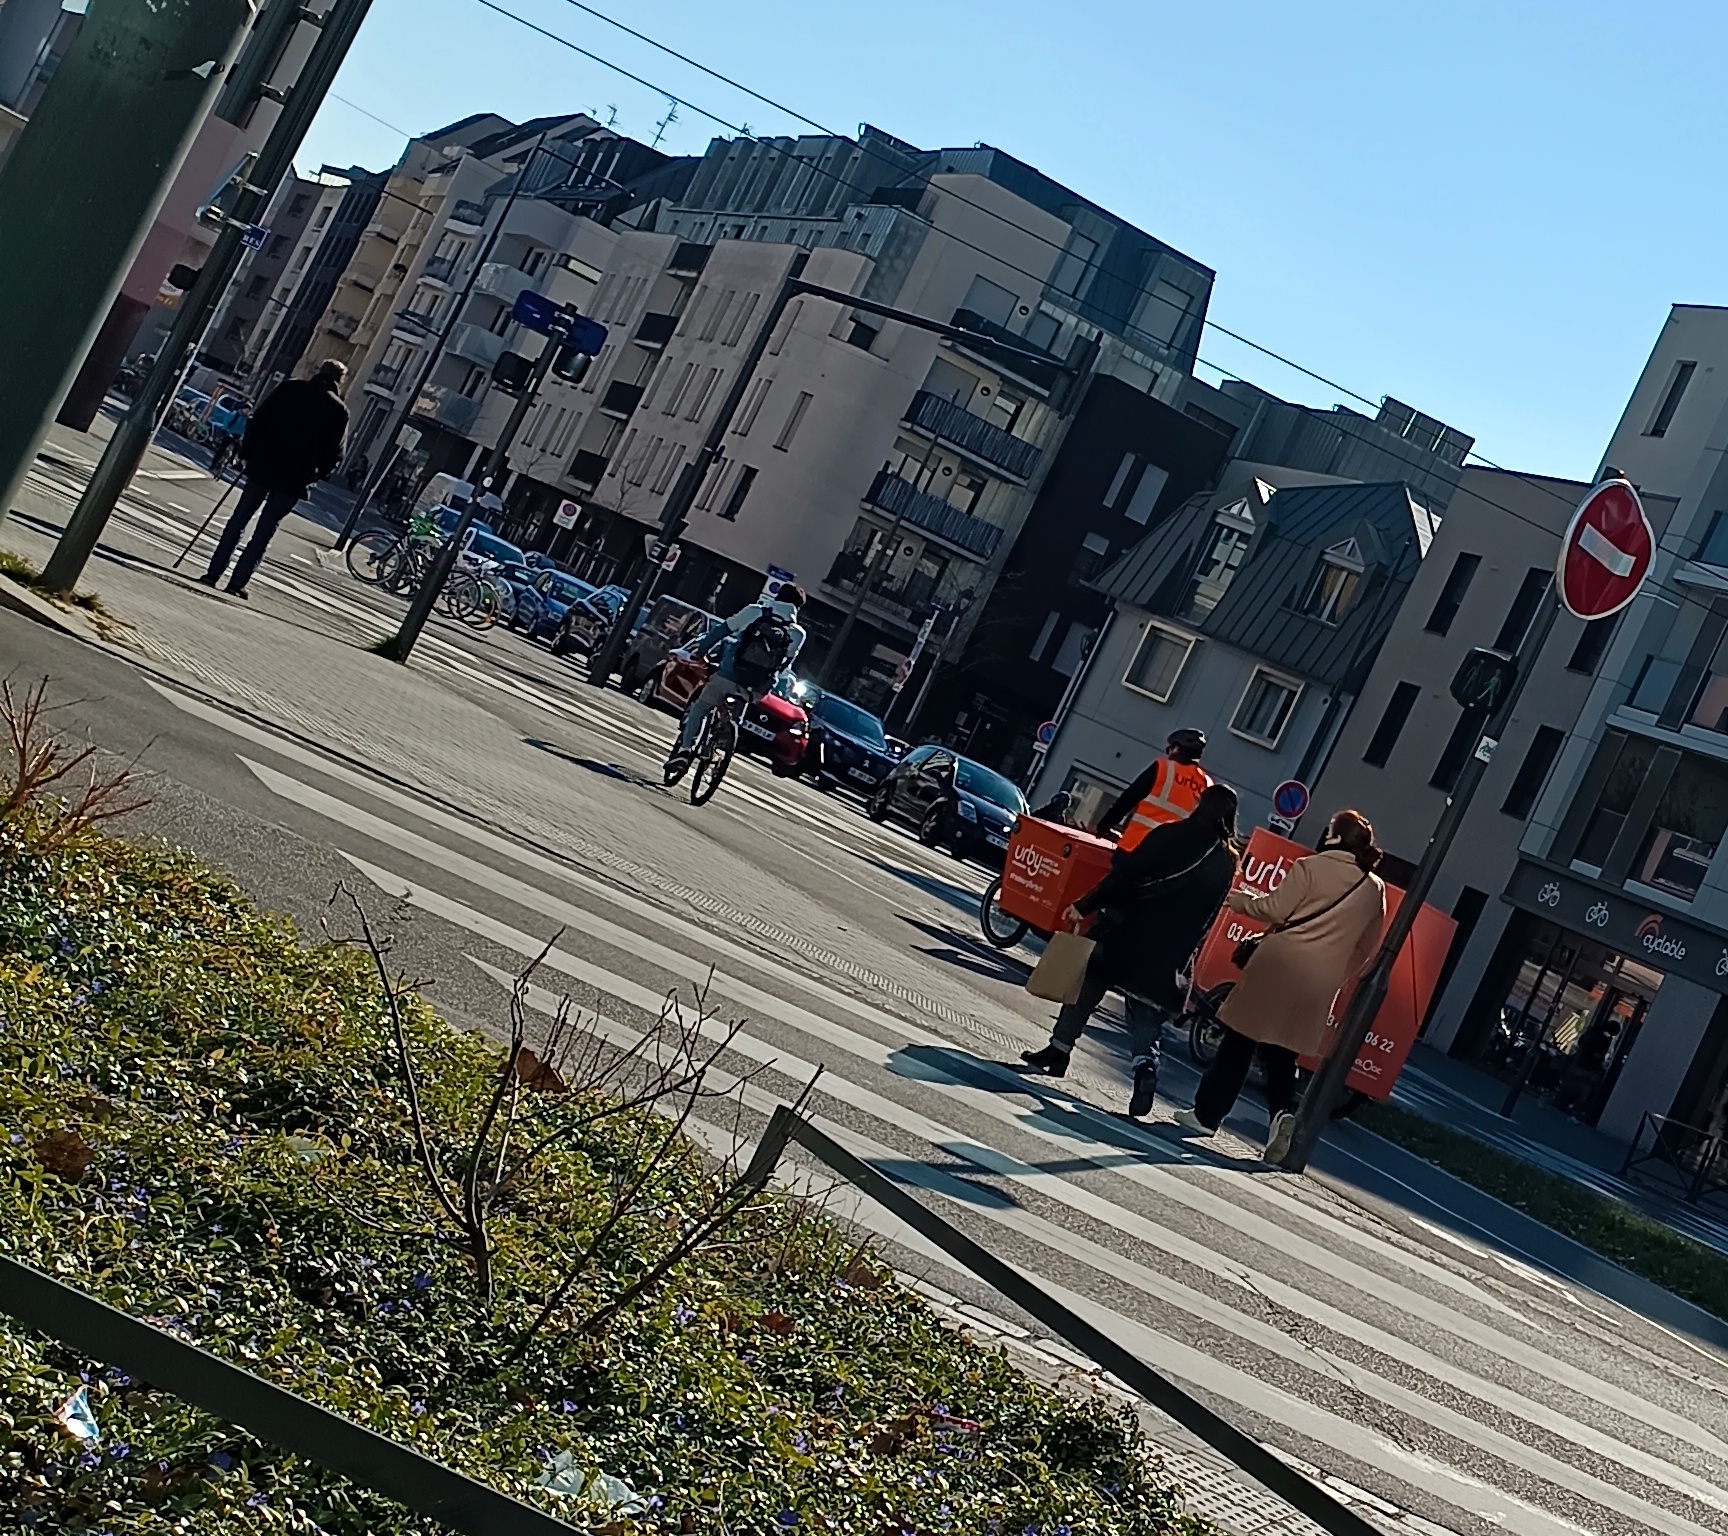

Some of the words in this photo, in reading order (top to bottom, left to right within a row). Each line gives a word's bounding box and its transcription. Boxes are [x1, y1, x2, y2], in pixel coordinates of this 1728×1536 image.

[1014, 844, 1043, 877] urby
[1245, 855, 1287, 892] urb
[1642, 933, 1687, 961] cyclable
[1364, 1031, 1380, 1046] 06
[1379, 1038, 1395, 1054] 22
